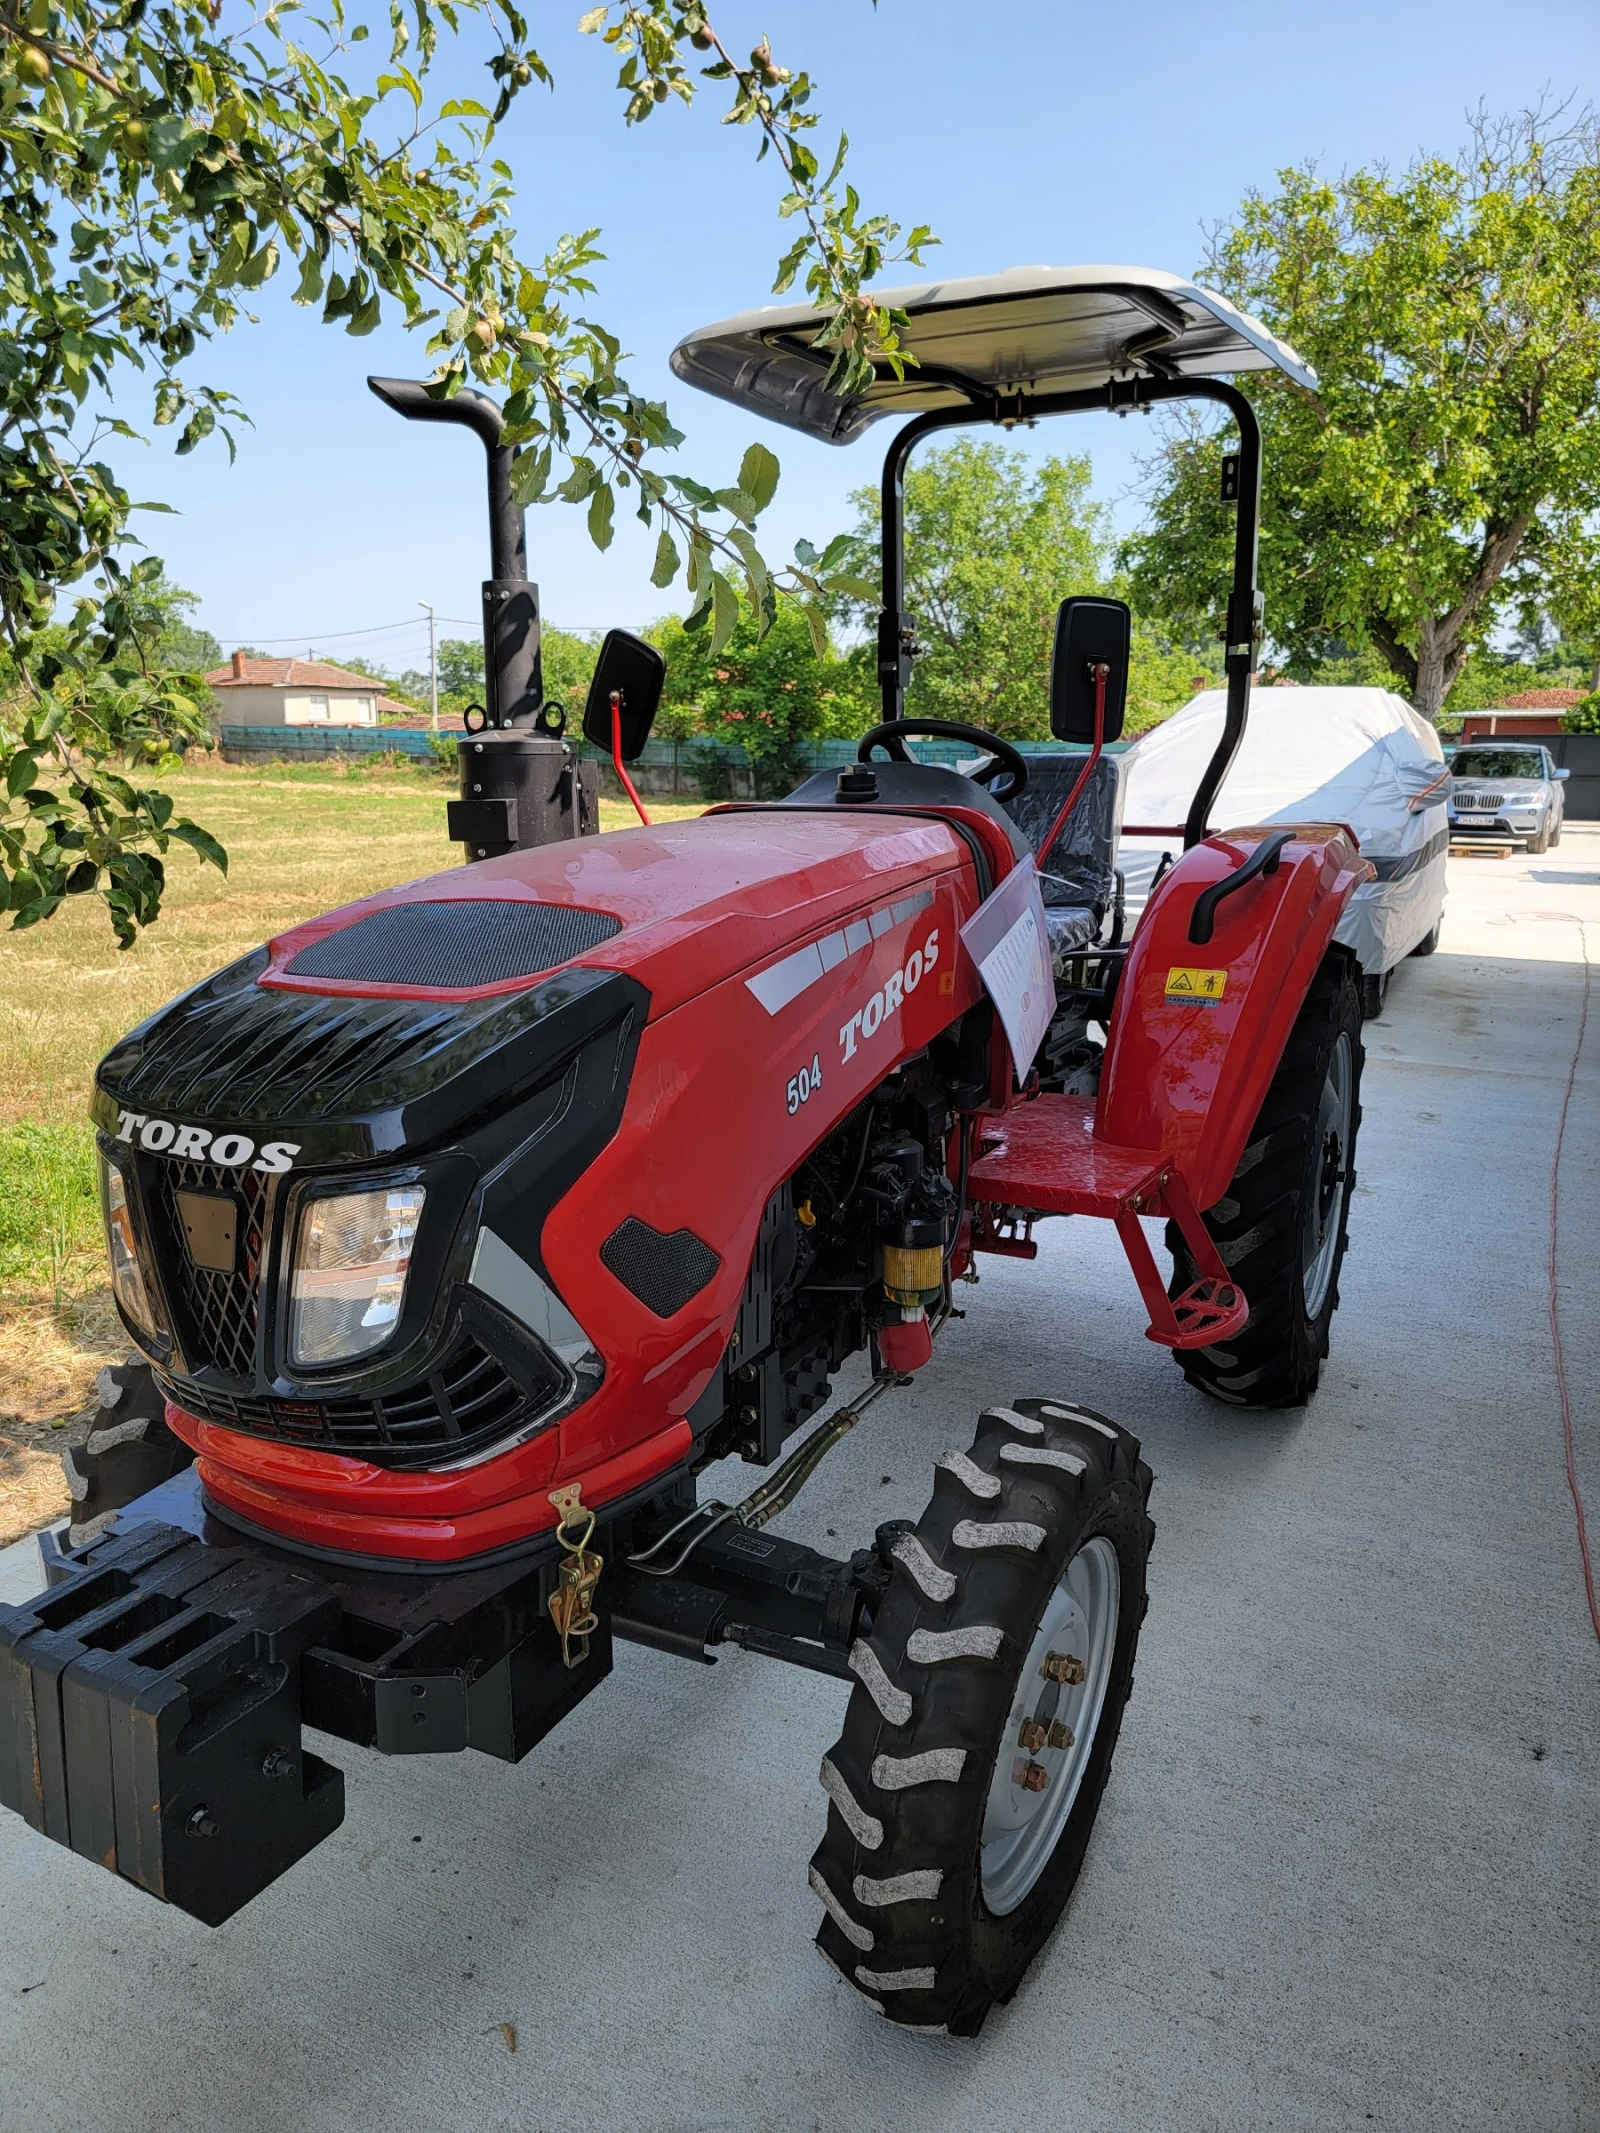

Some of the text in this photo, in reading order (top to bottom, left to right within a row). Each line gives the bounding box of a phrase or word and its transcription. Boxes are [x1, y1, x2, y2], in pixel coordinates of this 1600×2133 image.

[786, 928, 939, 1117] 504 TOROS
[115, 1109, 302, 1173] TOROS
